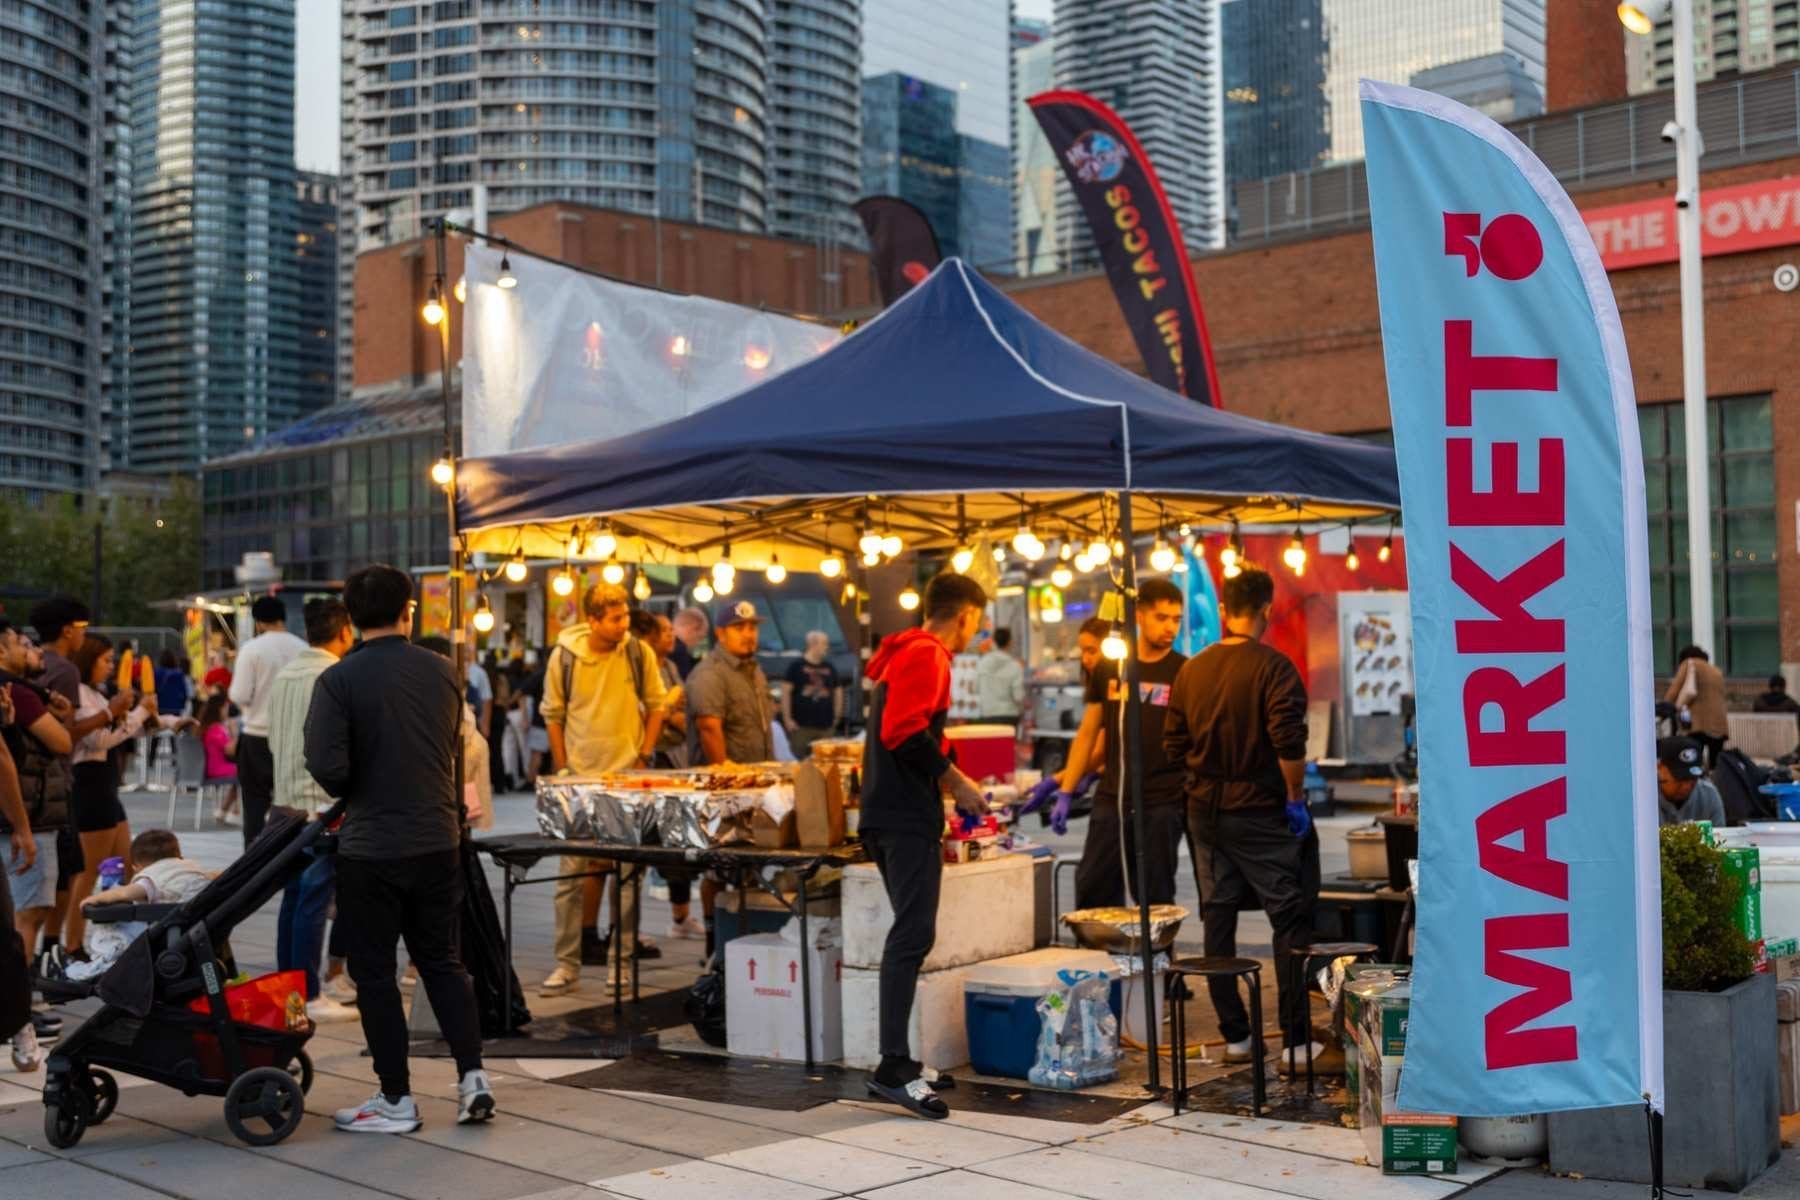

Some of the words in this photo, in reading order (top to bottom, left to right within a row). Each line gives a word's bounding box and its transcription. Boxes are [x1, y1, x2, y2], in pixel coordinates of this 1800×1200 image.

[1105, 184, 1168, 301] TACOS
[1588, 211, 1665, 255] THE
[1702, 188, 1800, 238] OW
[1445, 320, 1579, 1070] MARKET
